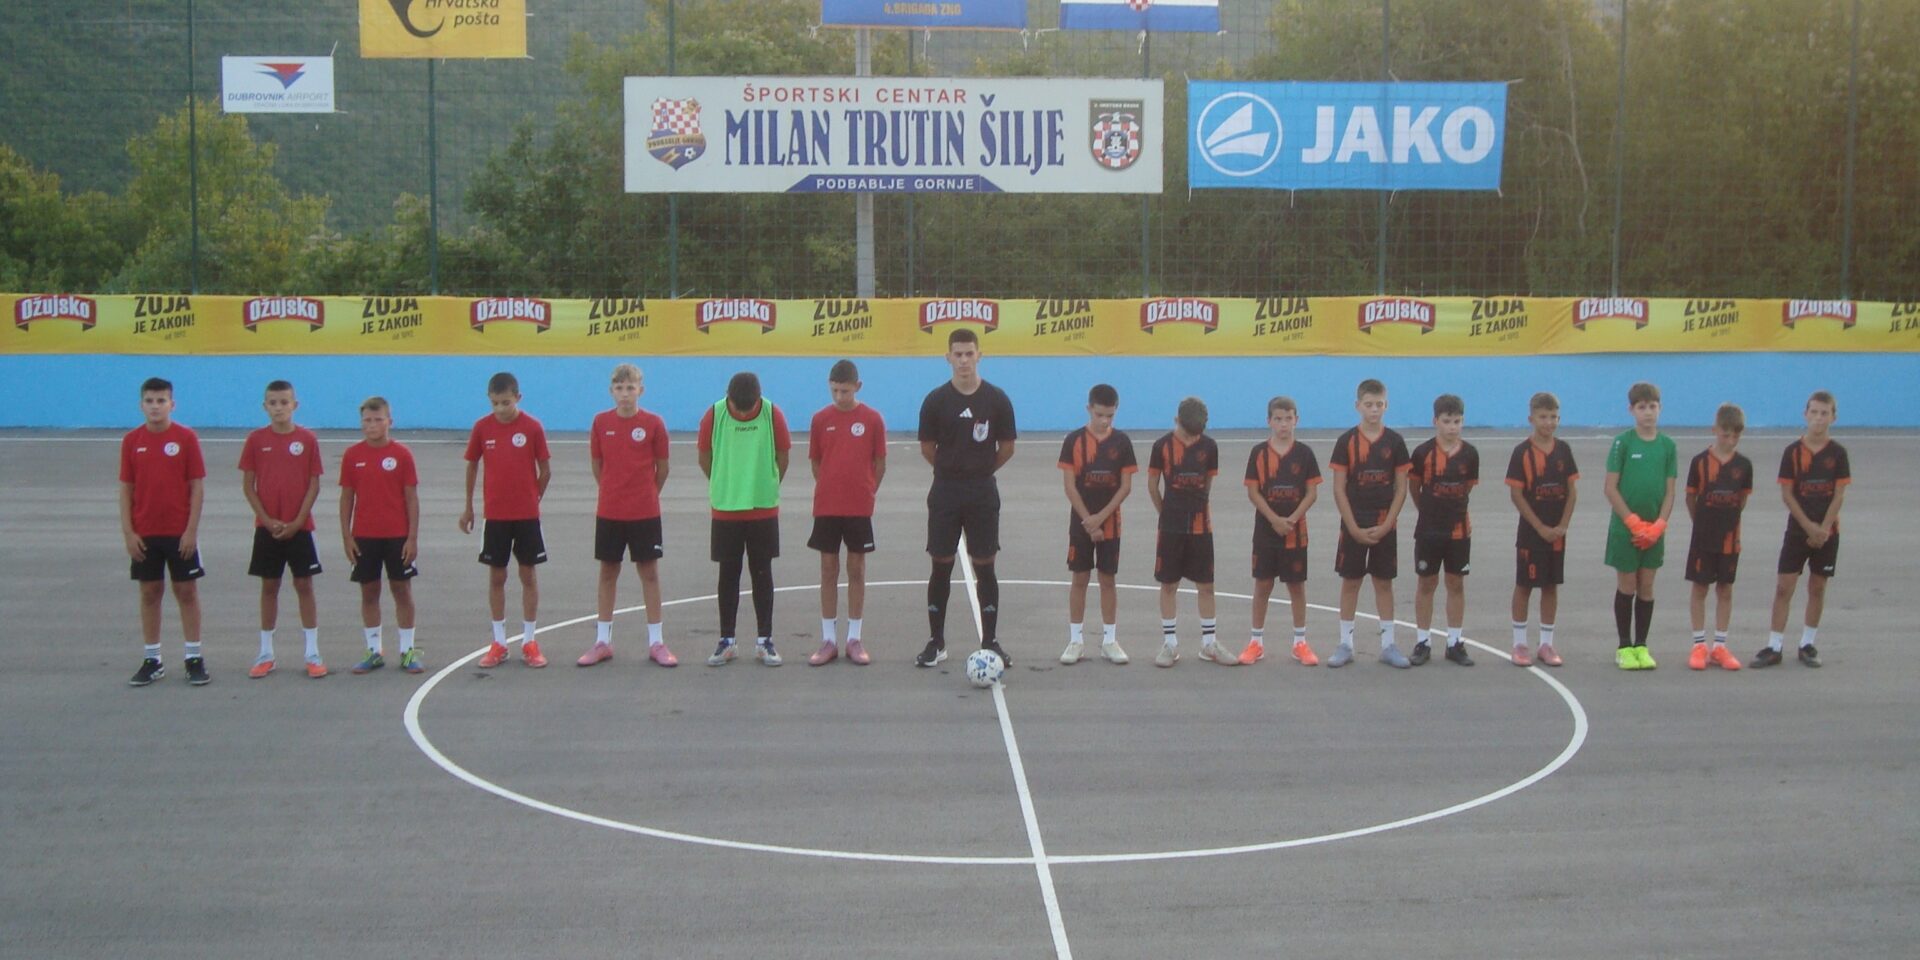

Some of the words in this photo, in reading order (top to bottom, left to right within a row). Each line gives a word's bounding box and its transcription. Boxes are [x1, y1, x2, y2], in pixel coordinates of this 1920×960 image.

[453, 12, 500, 28] pošta
[228, 93, 285, 101] DUBROVNIK
[743, 84, 860, 103] ŠPORTSKI
[876, 88, 967, 105] CENTAR
[724, 109, 831, 167] MILAN
[844, 109, 965, 168] TRUTIN
[979, 94, 1065, 176] ŠILJE
[1301, 105, 1497, 165] JAKO
[816, 179, 905, 190] PODBABLJE
[914, 179, 975, 190] GORNJE
[22, 297, 90, 320] Ožujsko
[249, 298, 318, 321] Ožujsko
[477, 298, 545, 321] Ožujsko
[702, 299, 770, 323] Ožujsko
[926, 300, 993, 323] Ožujsko
[1147, 299, 1213, 323] Ožujsko
[1365, 300, 1430, 323] Ožujsko
[133, 321, 147, 335] JE
[150, 313, 195, 332] ZAKON!
[361, 322, 374, 335] JE
[379, 313, 423, 332] ZAKON!
[587, 322, 600, 336] JE
[605, 315, 649, 334] ZAKON!
[812, 324, 824, 337] JE
[828, 316, 873, 335] ZAKON!
[1034, 322, 1047, 336] JE
[1050, 315, 1095, 334] ZAKON!
[1252, 324, 1265, 337] JE
[1269, 316, 1313, 335] ZAKON!
[1469, 323, 1482, 337] JE
[1485, 315, 1529, 334] ZAKON!
[1682, 320, 1695, 333] JE
[1698, 311, 1740, 329] ZAKON!
[1888, 321, 1901, 333] JE
